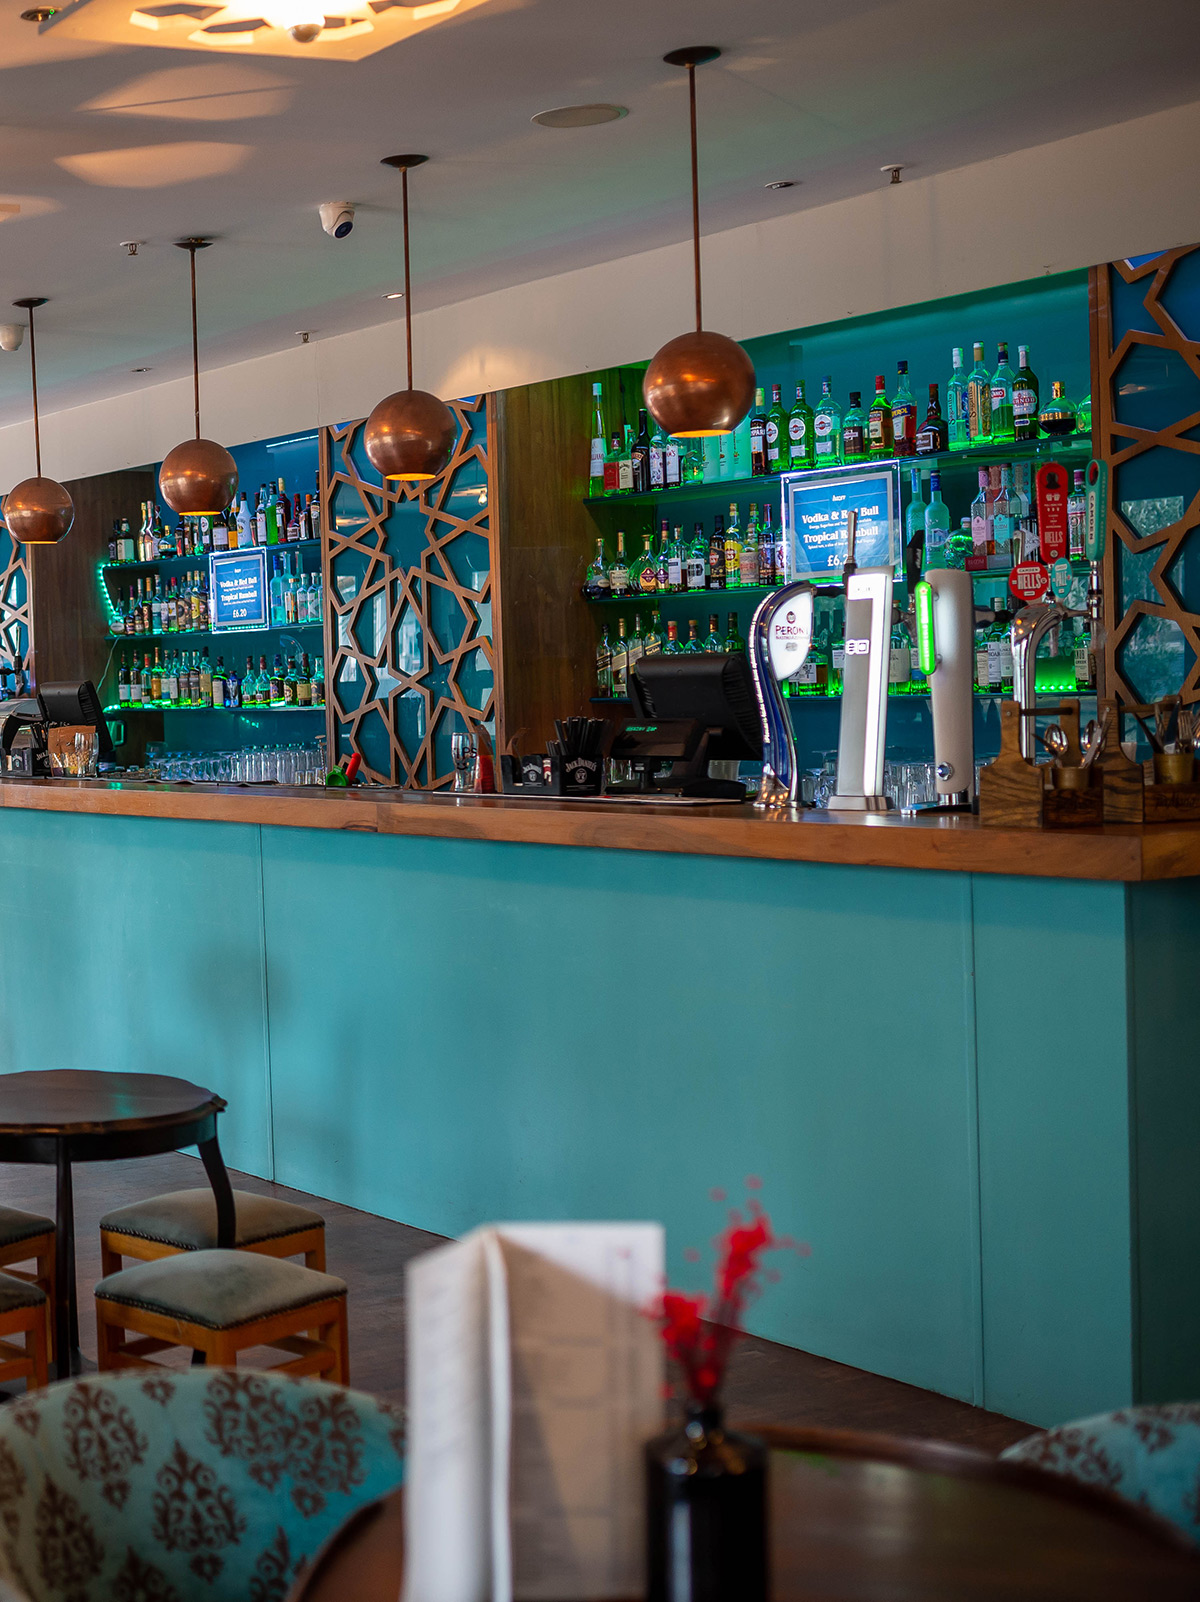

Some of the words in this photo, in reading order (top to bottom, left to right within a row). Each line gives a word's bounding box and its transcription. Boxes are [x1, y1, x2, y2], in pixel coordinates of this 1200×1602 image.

[802, 513, 829, 524] Vodka
[831, 511, 840, 520] &
[860, 505, 879, 516] Bull
[803, 531, 839, 544] Tropical
[840, 526, 879, 539] Rmbull
[1044, 531, 1063, 543] HELLS
[827, 553, 849, 567] £6.2
[1017, 573, 1042, 590] HELLS
